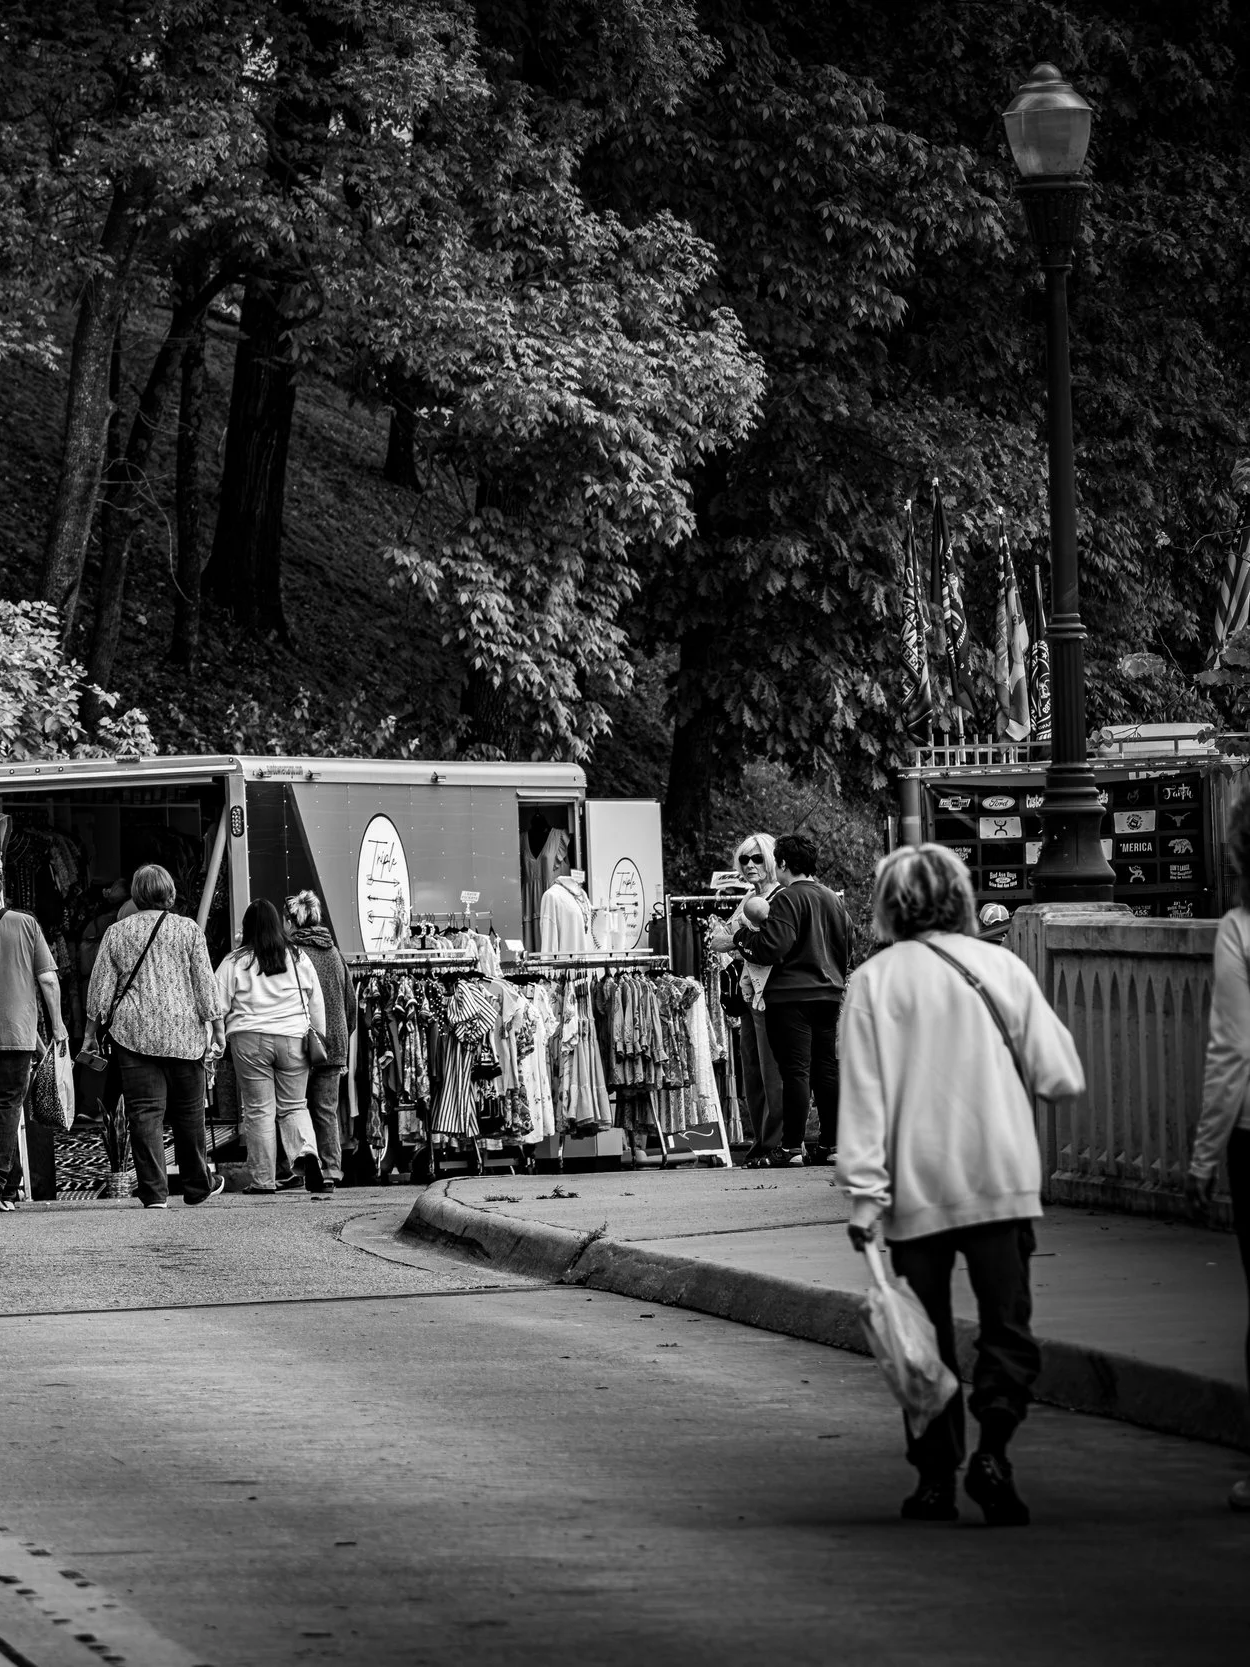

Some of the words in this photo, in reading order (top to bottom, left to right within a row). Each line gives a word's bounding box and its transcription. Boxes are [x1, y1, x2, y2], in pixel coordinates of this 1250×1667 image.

[989, 799, 1009, 808] Ford
[1119, 842, 1153, 853] 'MERICA
[368, 840, 398, 879] Triple
